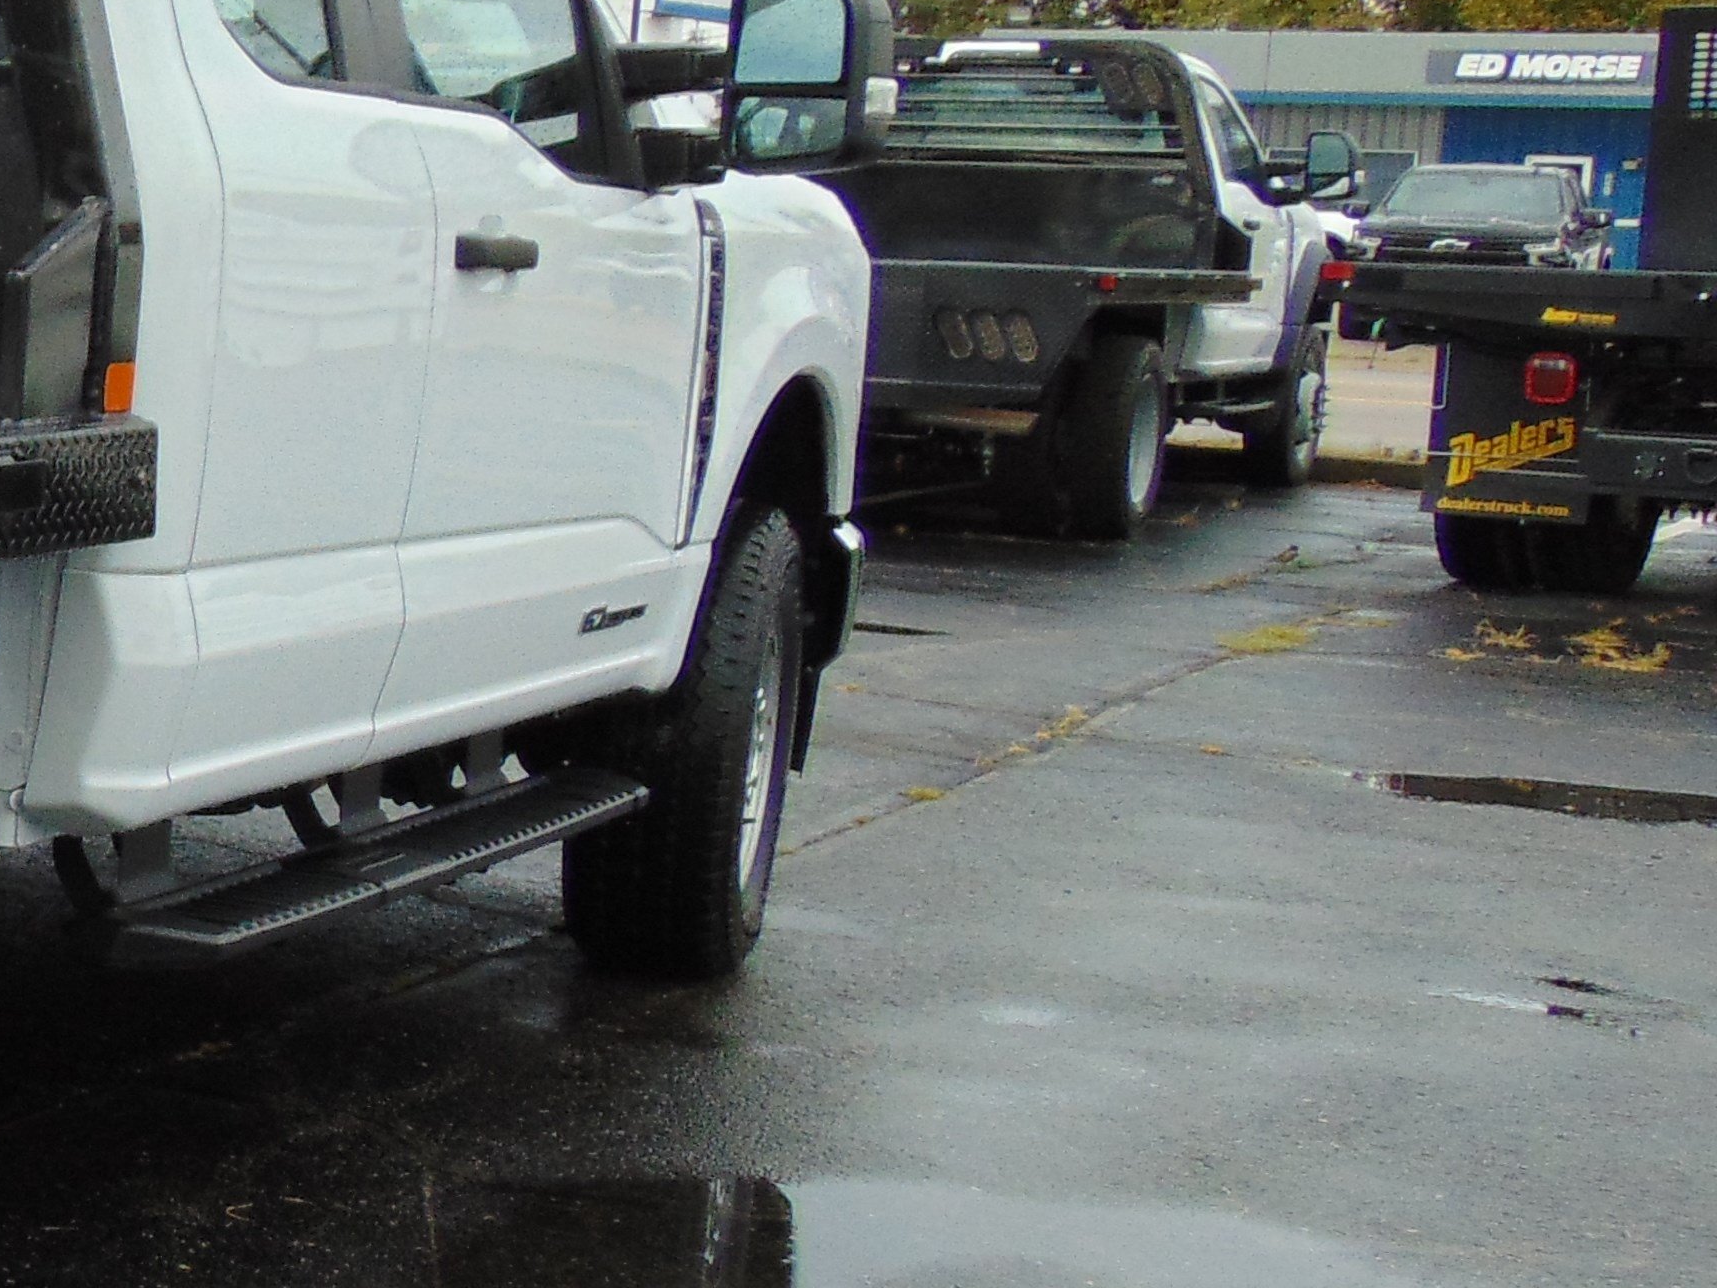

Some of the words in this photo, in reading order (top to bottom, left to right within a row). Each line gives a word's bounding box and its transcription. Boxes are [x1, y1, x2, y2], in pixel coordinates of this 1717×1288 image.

[1454, 53, 1507, 78] ED
[1509, 54, 1643, 81] MORSE
[1445, 415, 1578, 488] Dealers
[1435, 495, 1572, 517] dealerstruck.com
